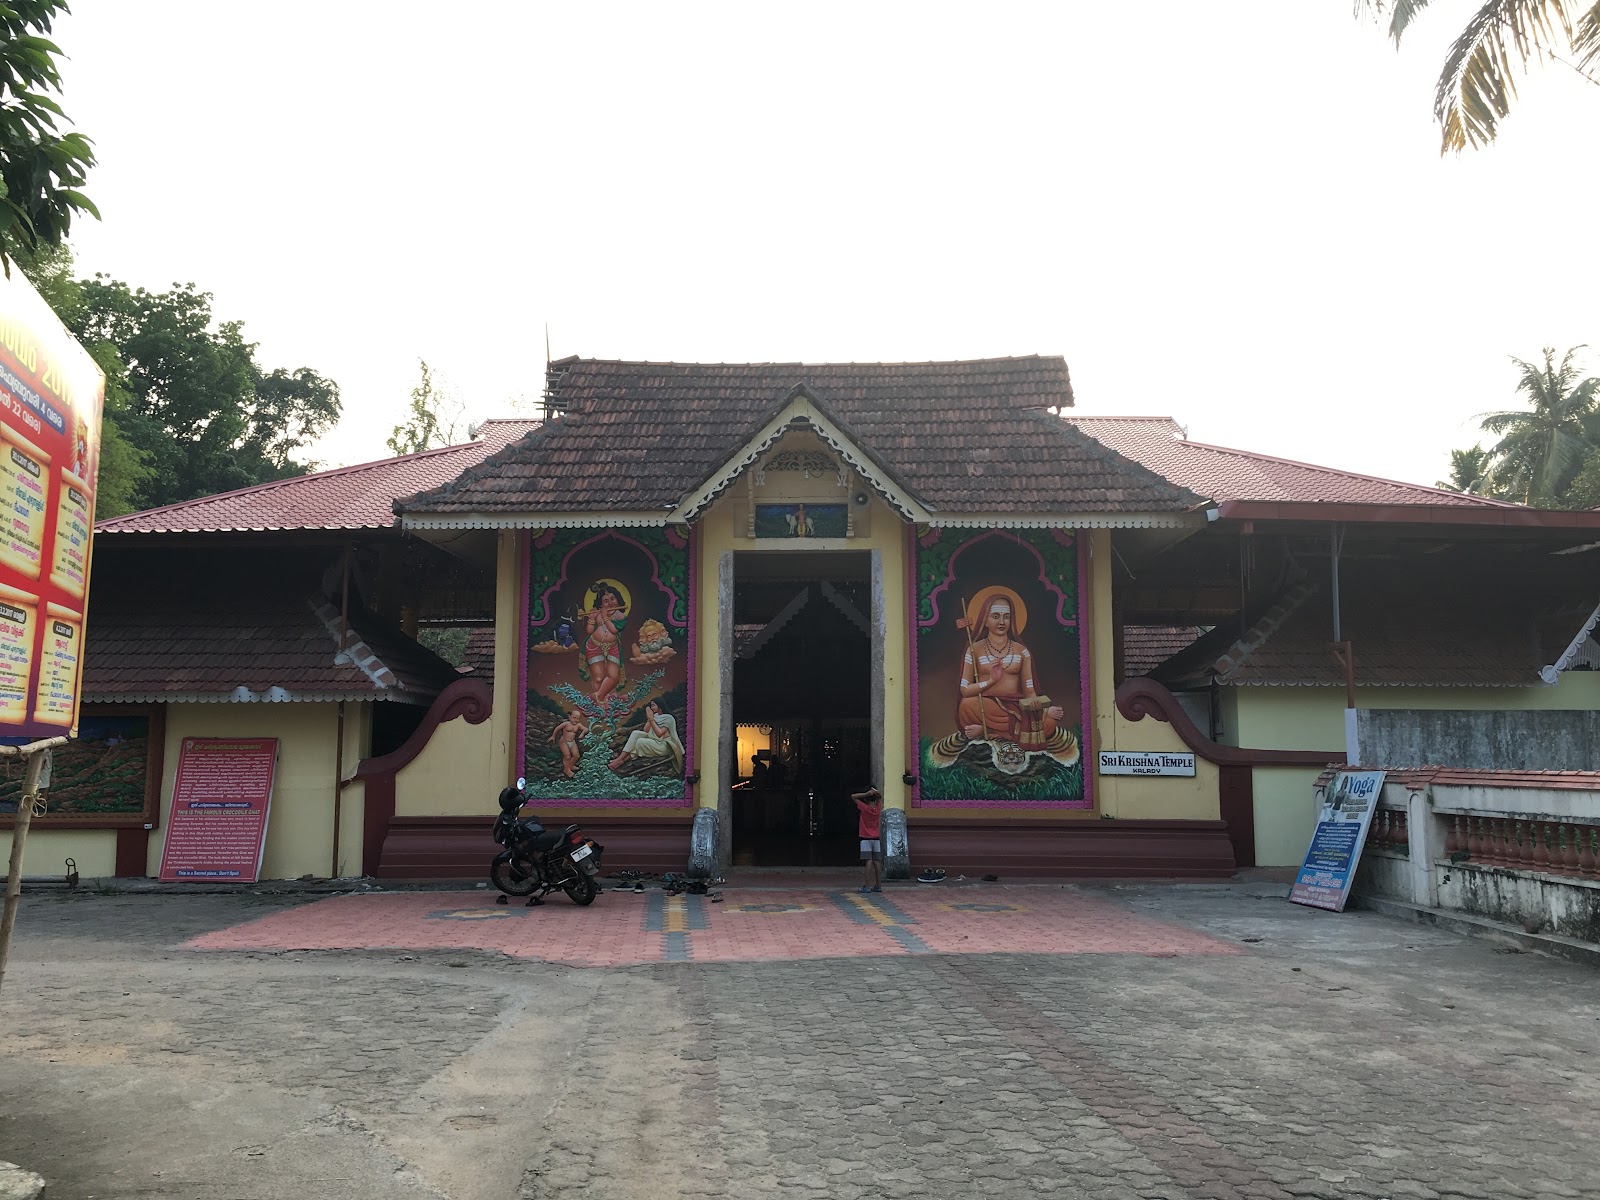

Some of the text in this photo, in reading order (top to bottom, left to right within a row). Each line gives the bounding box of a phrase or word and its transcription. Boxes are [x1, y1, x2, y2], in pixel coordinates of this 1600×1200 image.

[12, 401, 21, 418] 22
[40, 404, 46, 415] 4
[1118, 755, 1160, 767] KRISHNA
[1160, 756, 1193, 768] TEMPLE
[1348, 776, 1375, 797] Yoga
